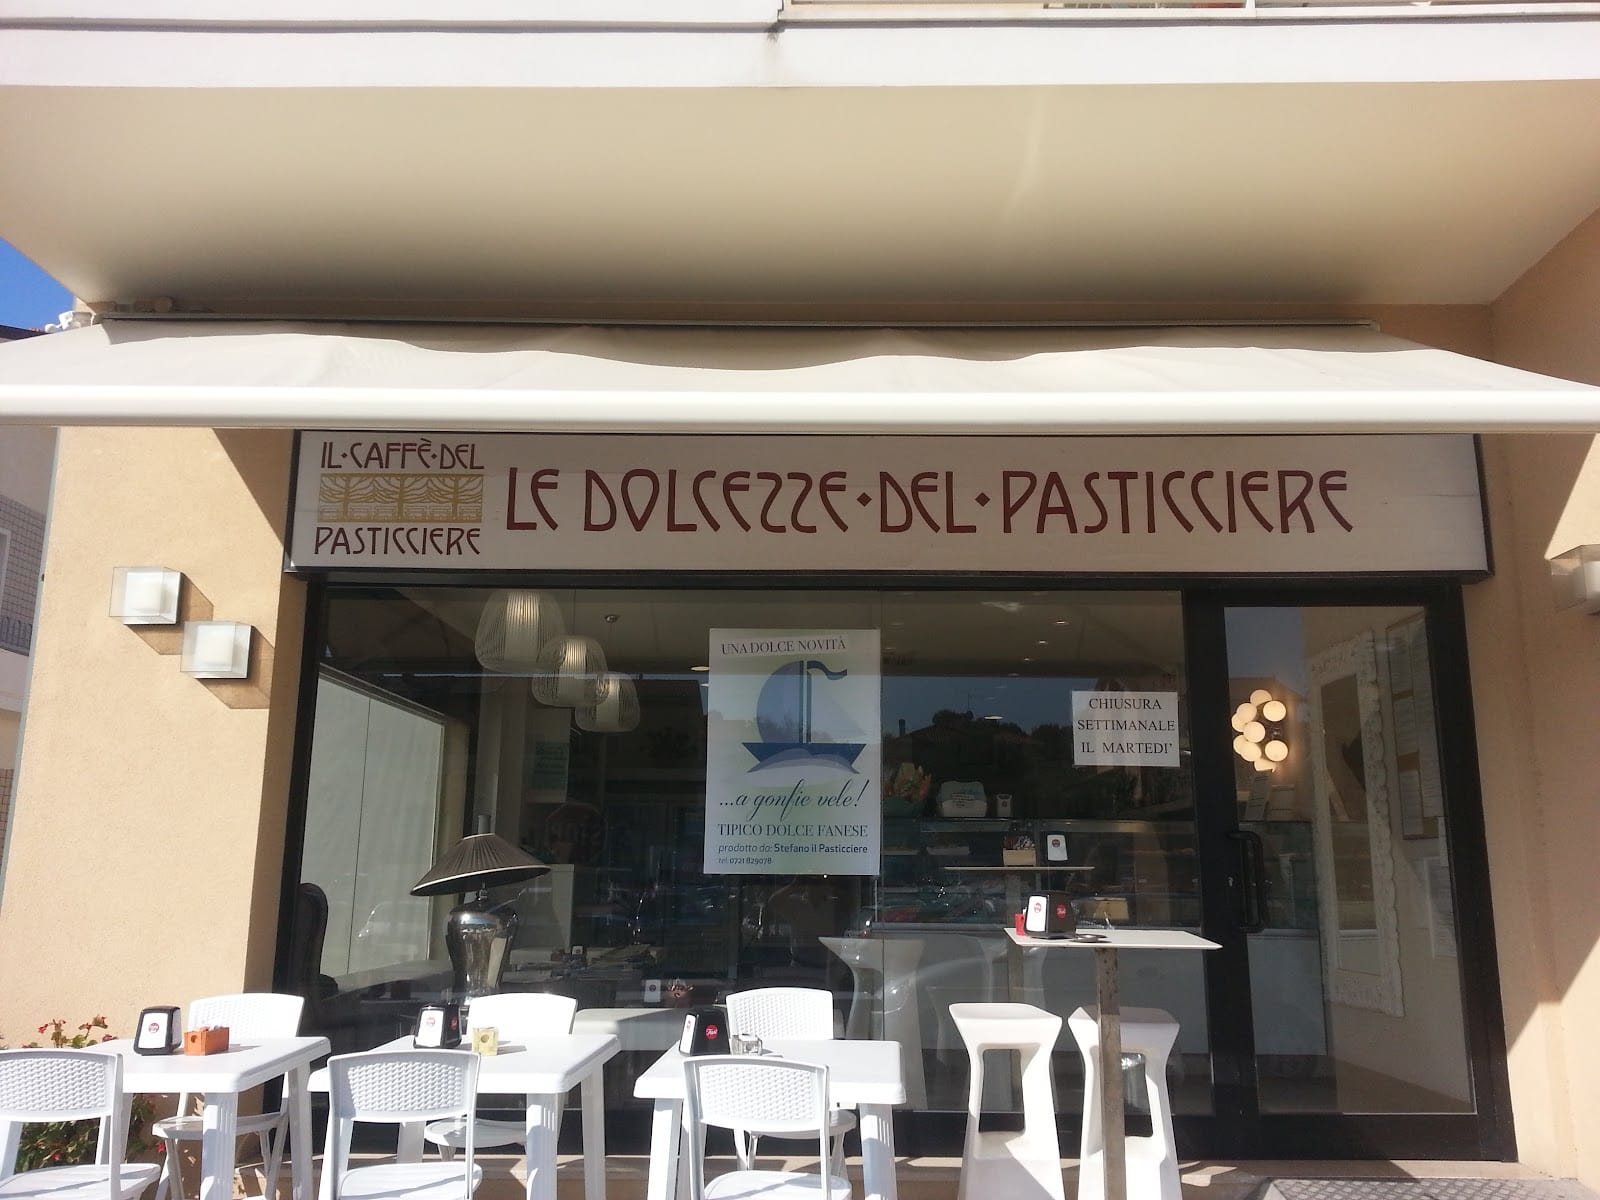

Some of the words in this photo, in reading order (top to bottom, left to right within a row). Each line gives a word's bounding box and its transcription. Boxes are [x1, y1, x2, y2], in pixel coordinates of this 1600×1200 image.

[507, 467, 560, 531] LE
[314, 527, 481, 555] PASTICCIERE
[721, 643, 748, 655] UNA
[750, 640, 795, 653] DOLCE
[798, 635, 846, 650] NOVITÀ
[1088, 698, 1162, 710] CHIUSURA
[1077, 719, 1176, 731] SETTIMANALE
[1081, 742, 1095, 753] IL
[747, 778, 811, 823] gonfie
[817, 778, 870, 807] vele!
[717, 823, 763, 837] TIPICO
[766, 824, 815, 837] DOLCE
[818, 824, 869, 838] FANESE
[773, 842, 810, 853] Stefano
[811, 843, 818, 853] il
[819, 843, 868, 854] Pasticciere
